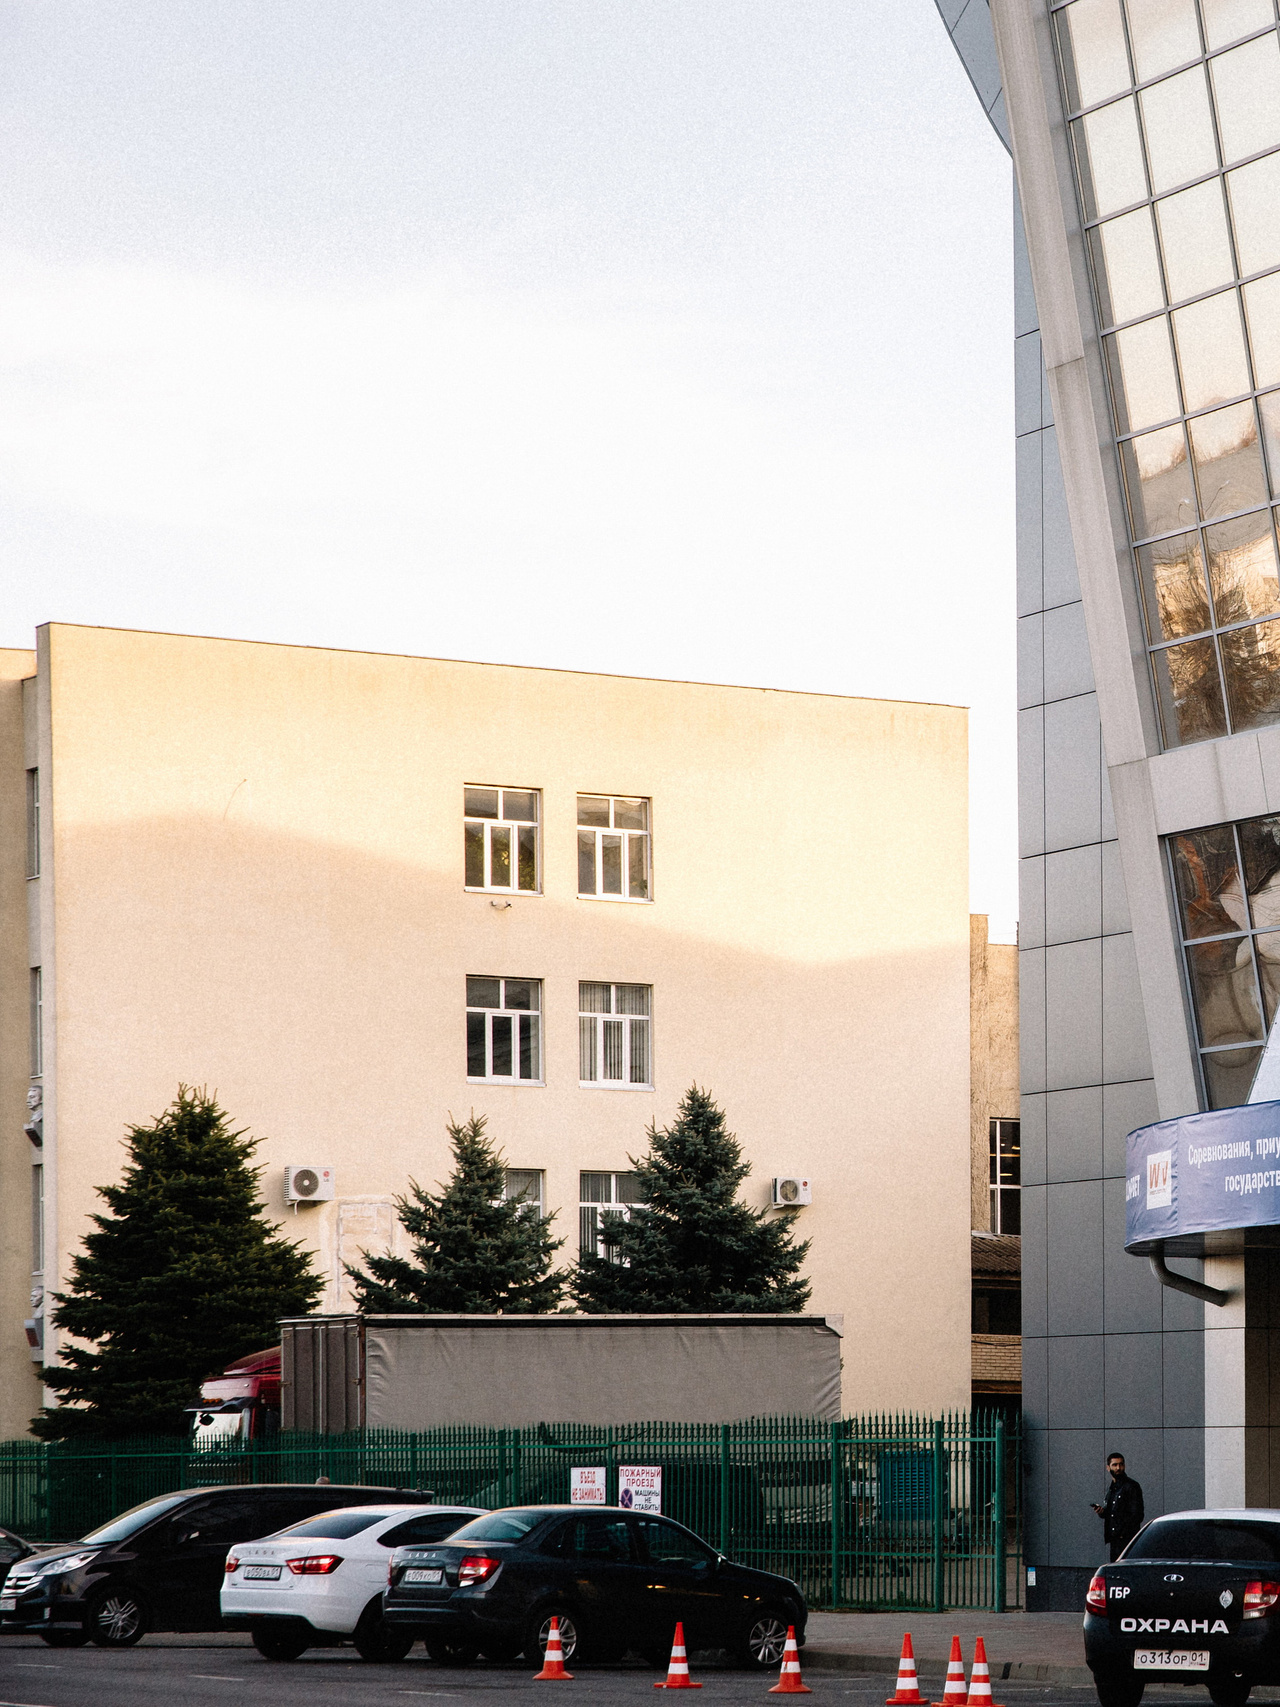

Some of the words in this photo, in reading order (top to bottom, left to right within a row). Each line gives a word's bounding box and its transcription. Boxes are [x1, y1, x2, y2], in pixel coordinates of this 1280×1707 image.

[1188, 1140, 1254, 1169] Соревнования,
[620, 1467, 661, 1477] ПОЖАРНЫЙ
[626, 1478, 655, 1488] ПРОЕЗД
[1109, 1586, 1131, 1599] ГБР
[1120, 1617, 1230, 1634] ОХРАНА
